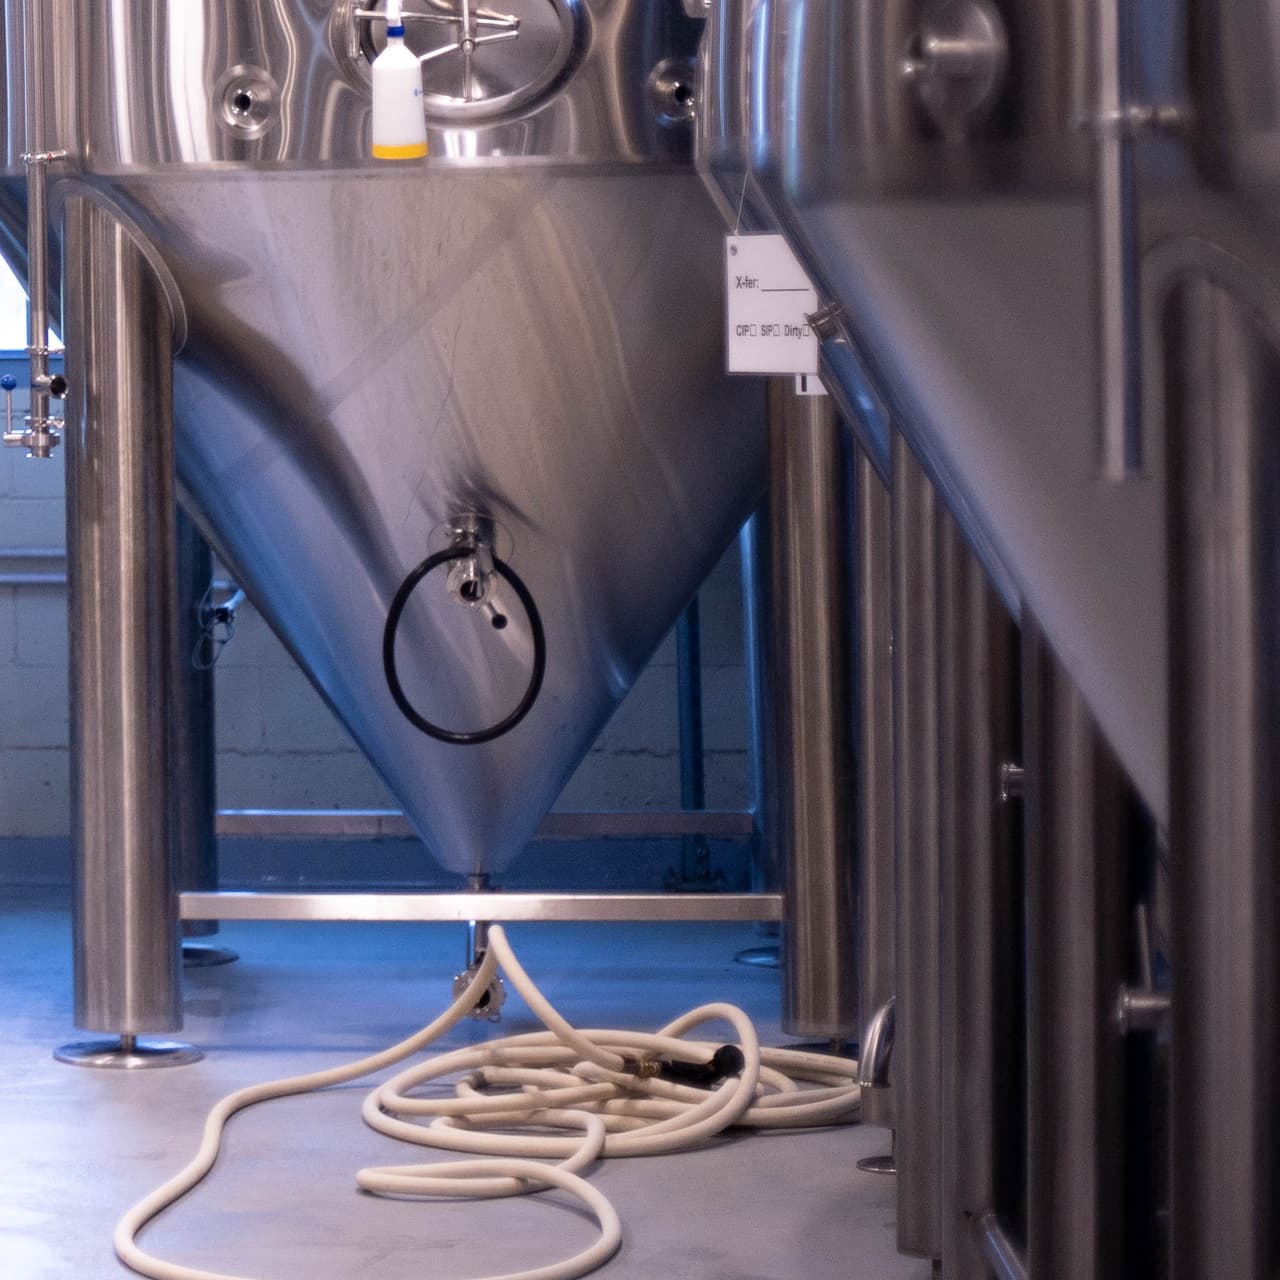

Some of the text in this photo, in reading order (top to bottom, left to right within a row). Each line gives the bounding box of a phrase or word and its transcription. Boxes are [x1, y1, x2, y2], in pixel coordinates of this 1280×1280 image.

[736, 275, 759, 289] X-fer:
[736, 324, 803, 340] CIP SIP Dirty
